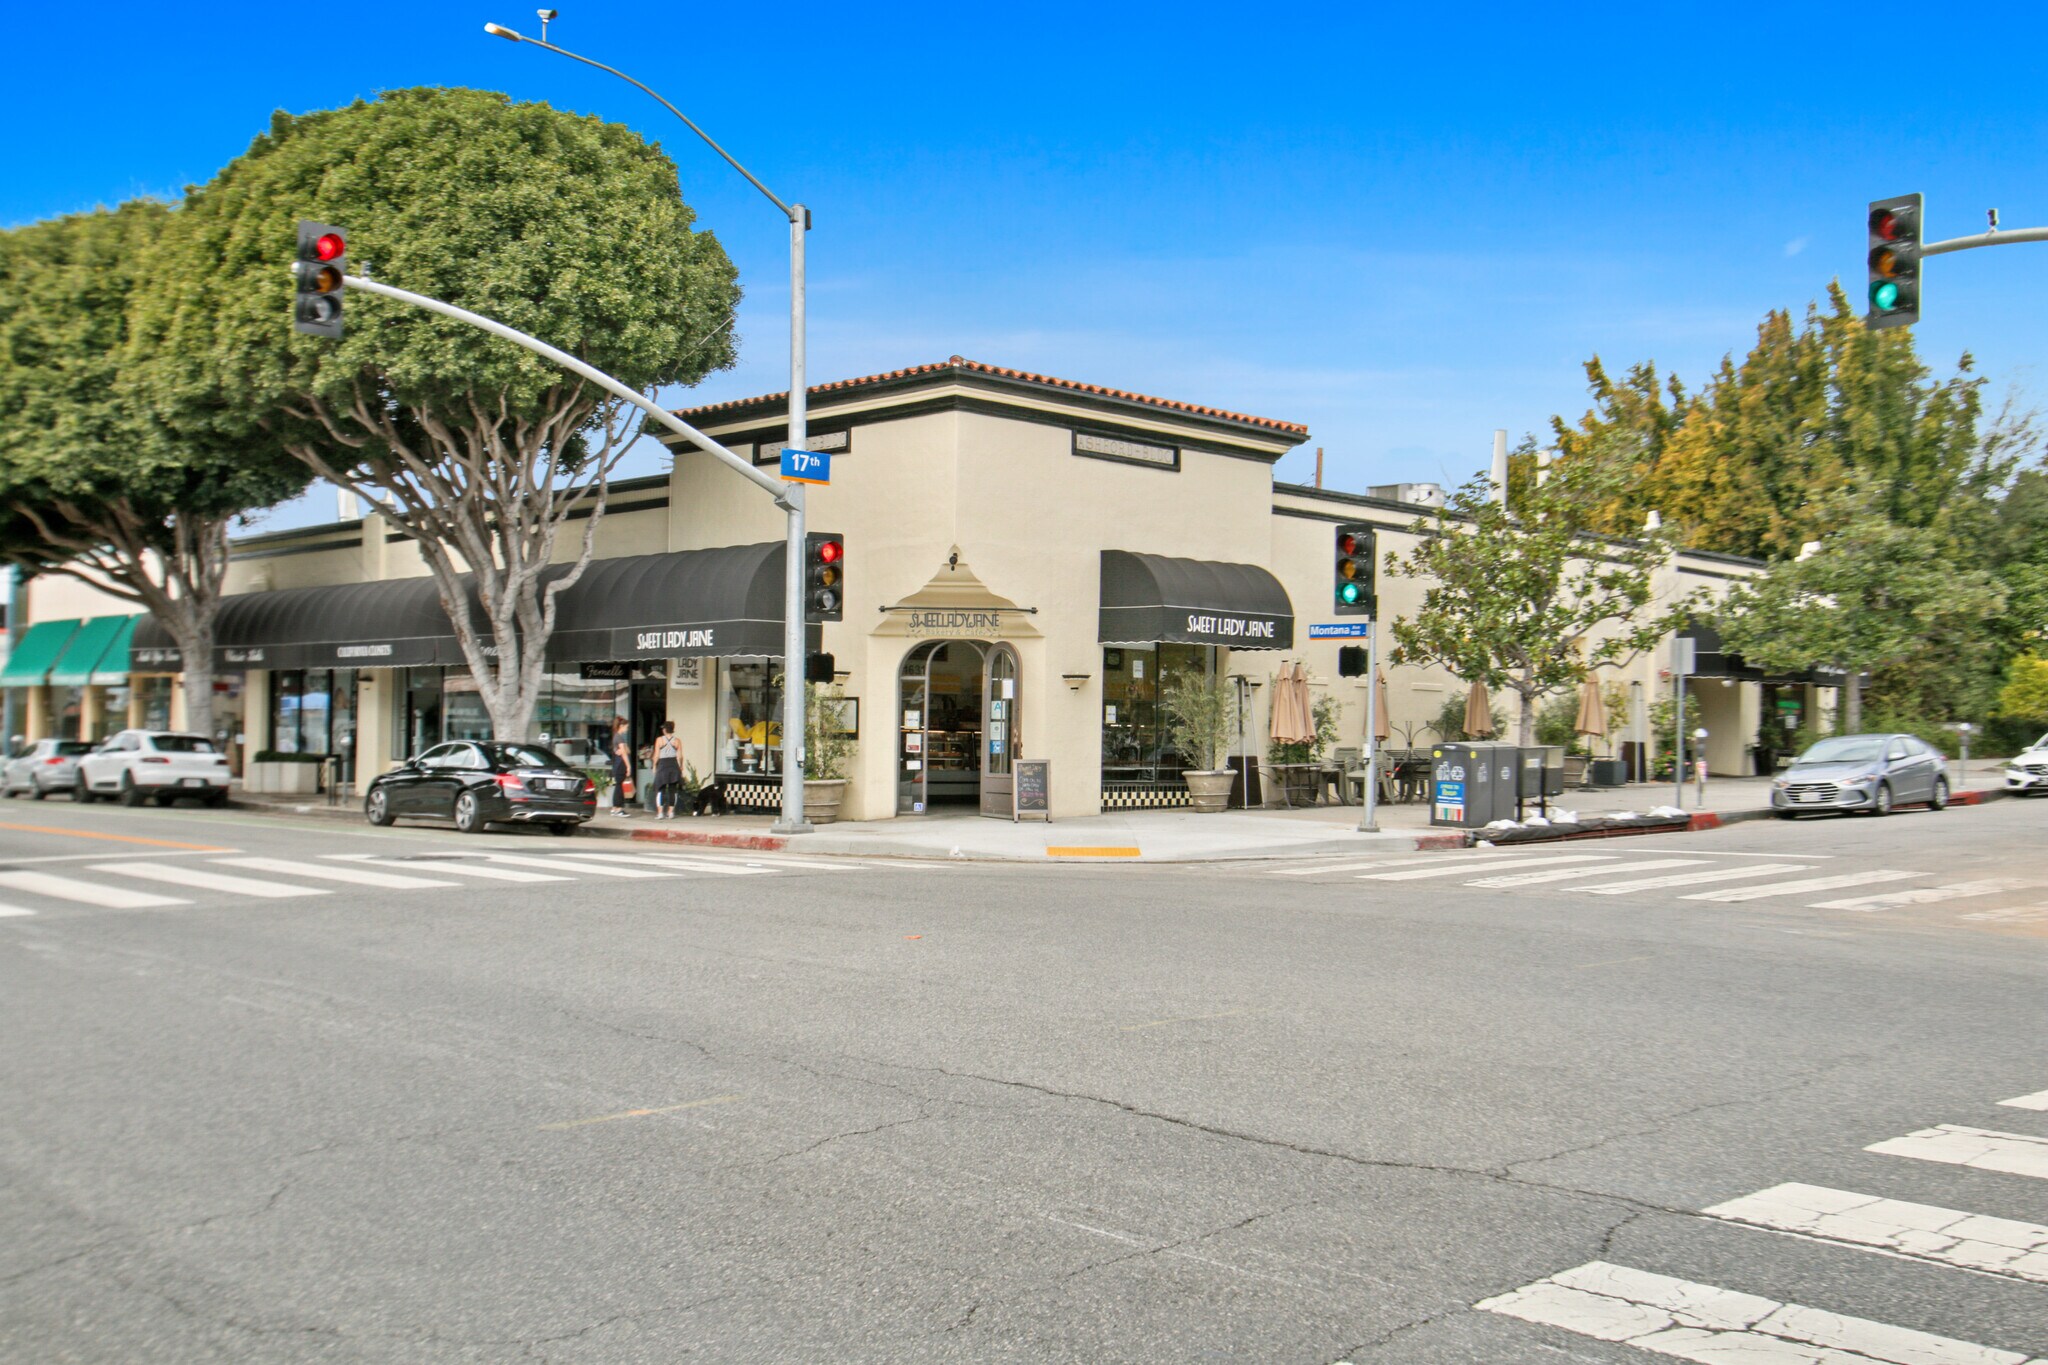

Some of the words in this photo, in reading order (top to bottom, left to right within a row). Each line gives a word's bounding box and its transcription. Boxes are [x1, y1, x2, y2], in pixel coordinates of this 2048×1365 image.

[792, 453, 820, 472] 17th
[1186, 615, 1217, 633] SWEET
[1218, 618, 1246, 636] LADY
[1245, 620, 1274, 638] JANE
[1310, 625, 1350, 635] Montana
[636, 632, 661, 650] SWEET
[662, 630, 687, 648] LADY
[686, 629, 714, 647] JANE
[677, 657, 698, 668] LADY
[677, 668, 698, 679] JANE
